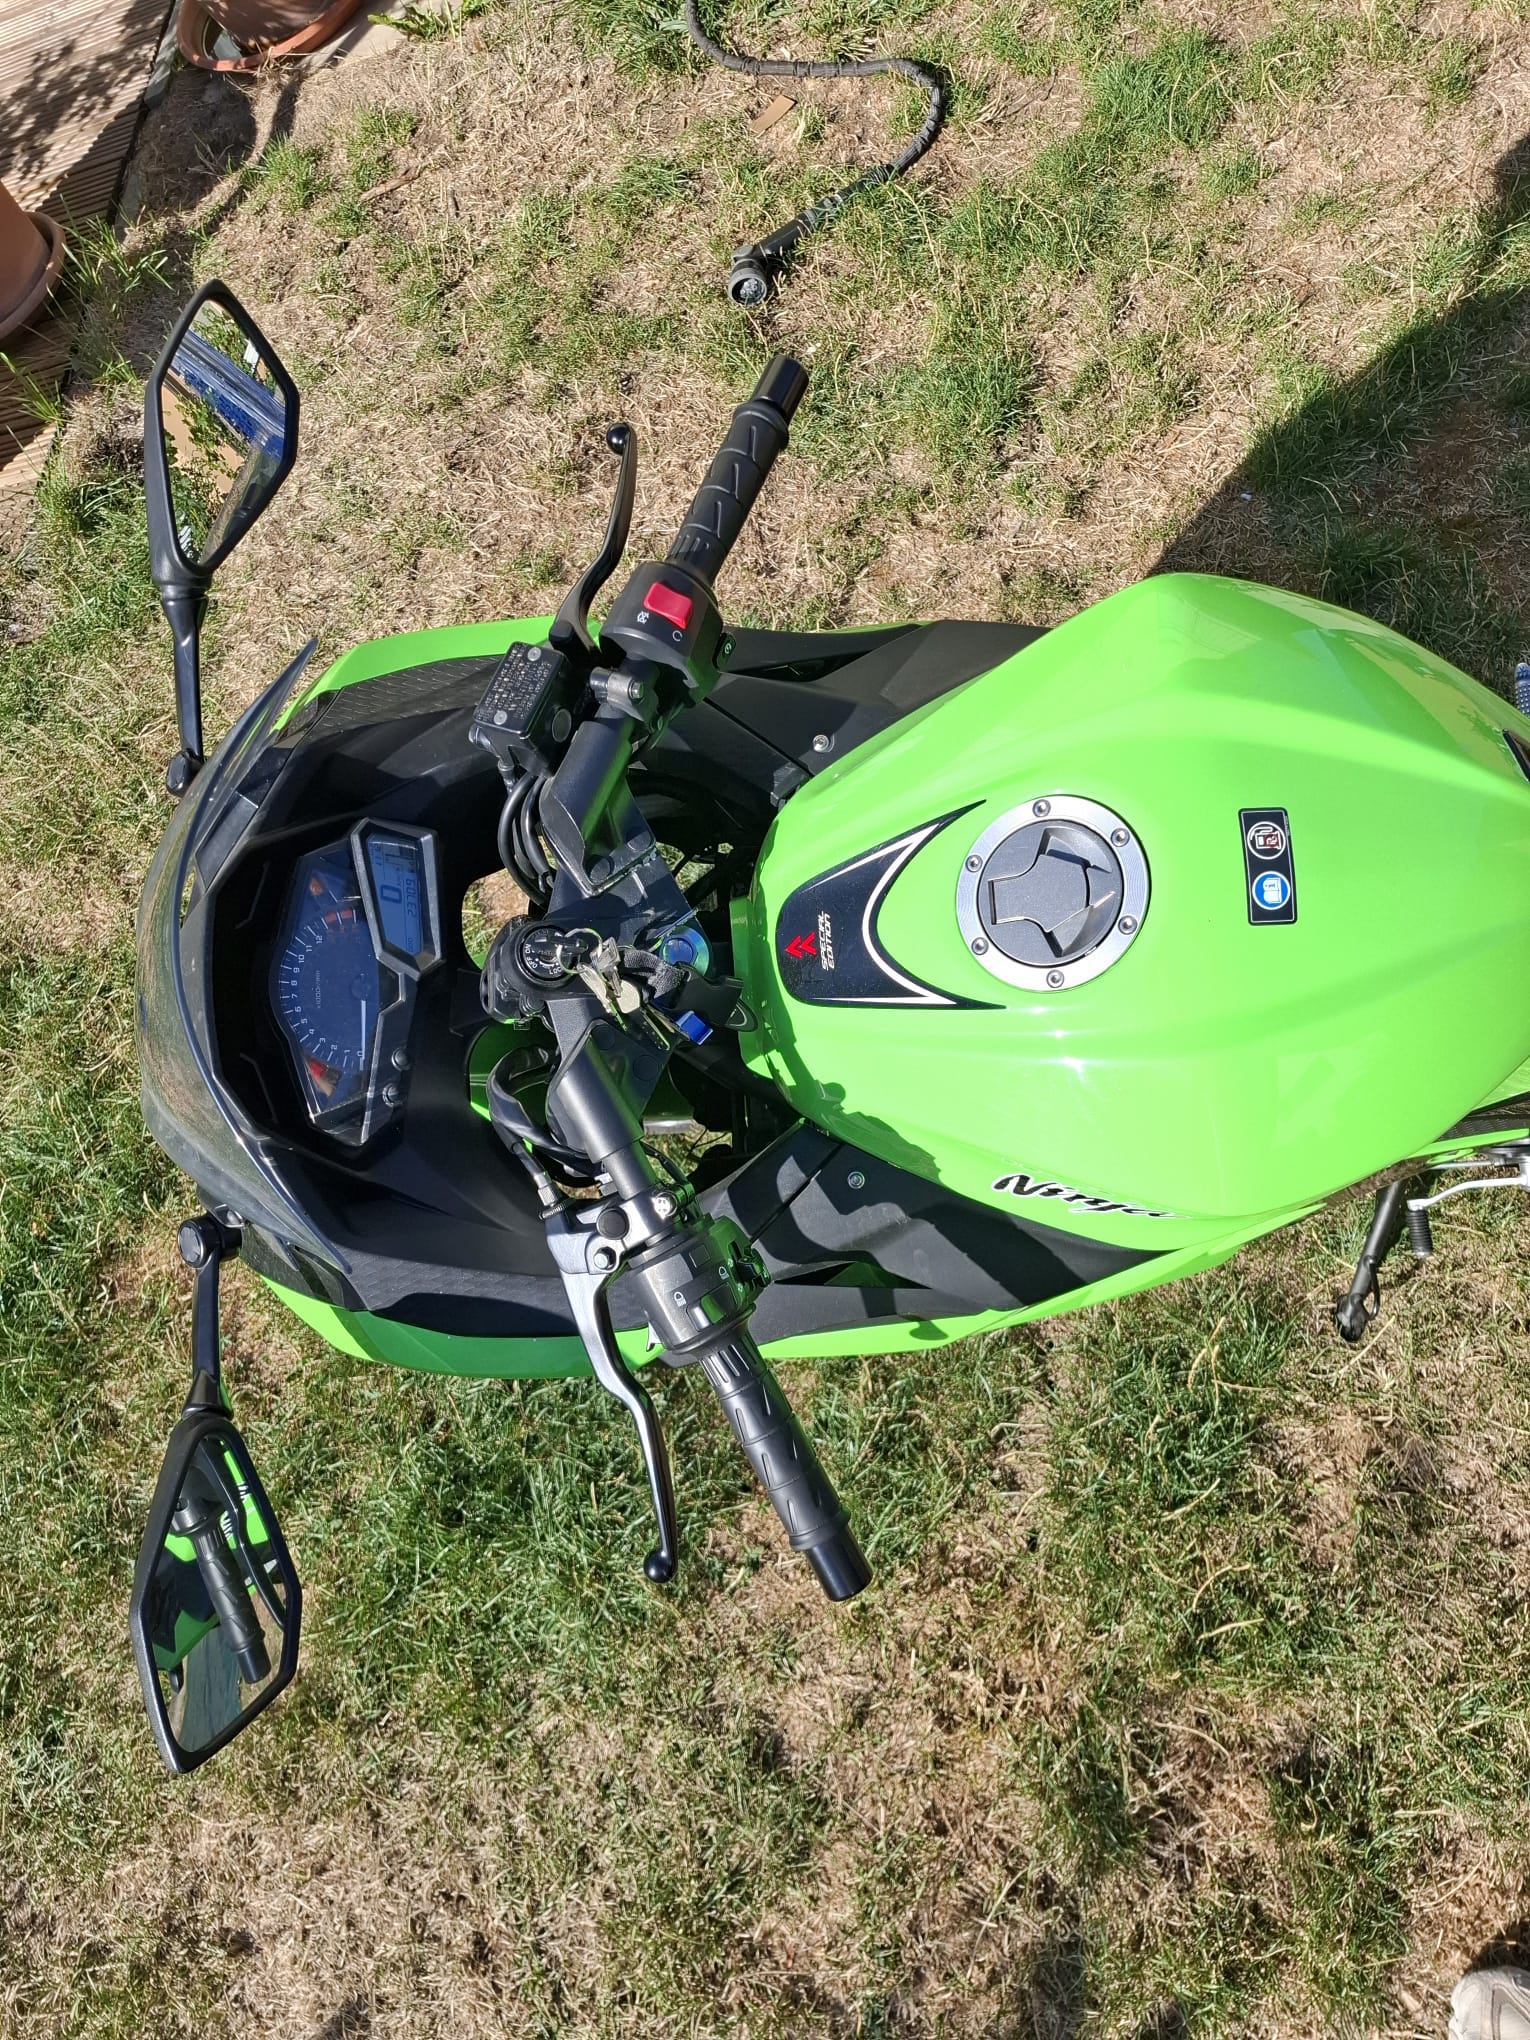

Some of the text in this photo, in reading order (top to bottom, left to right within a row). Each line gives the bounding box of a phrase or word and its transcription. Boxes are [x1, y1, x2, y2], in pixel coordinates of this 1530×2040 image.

[405, 878, 416, 917] 23709
[316, 935, 322, 944] 12
[525, 943, 532, 953] ON
[817, 910, 829, 971] SPECIAL
[824, 913, 835, 969] EDITION
[298, 954, 304, 963] 10
[526, 956, 537, 968] OFF
[991, 1172, 1186, 1219] Ninja
